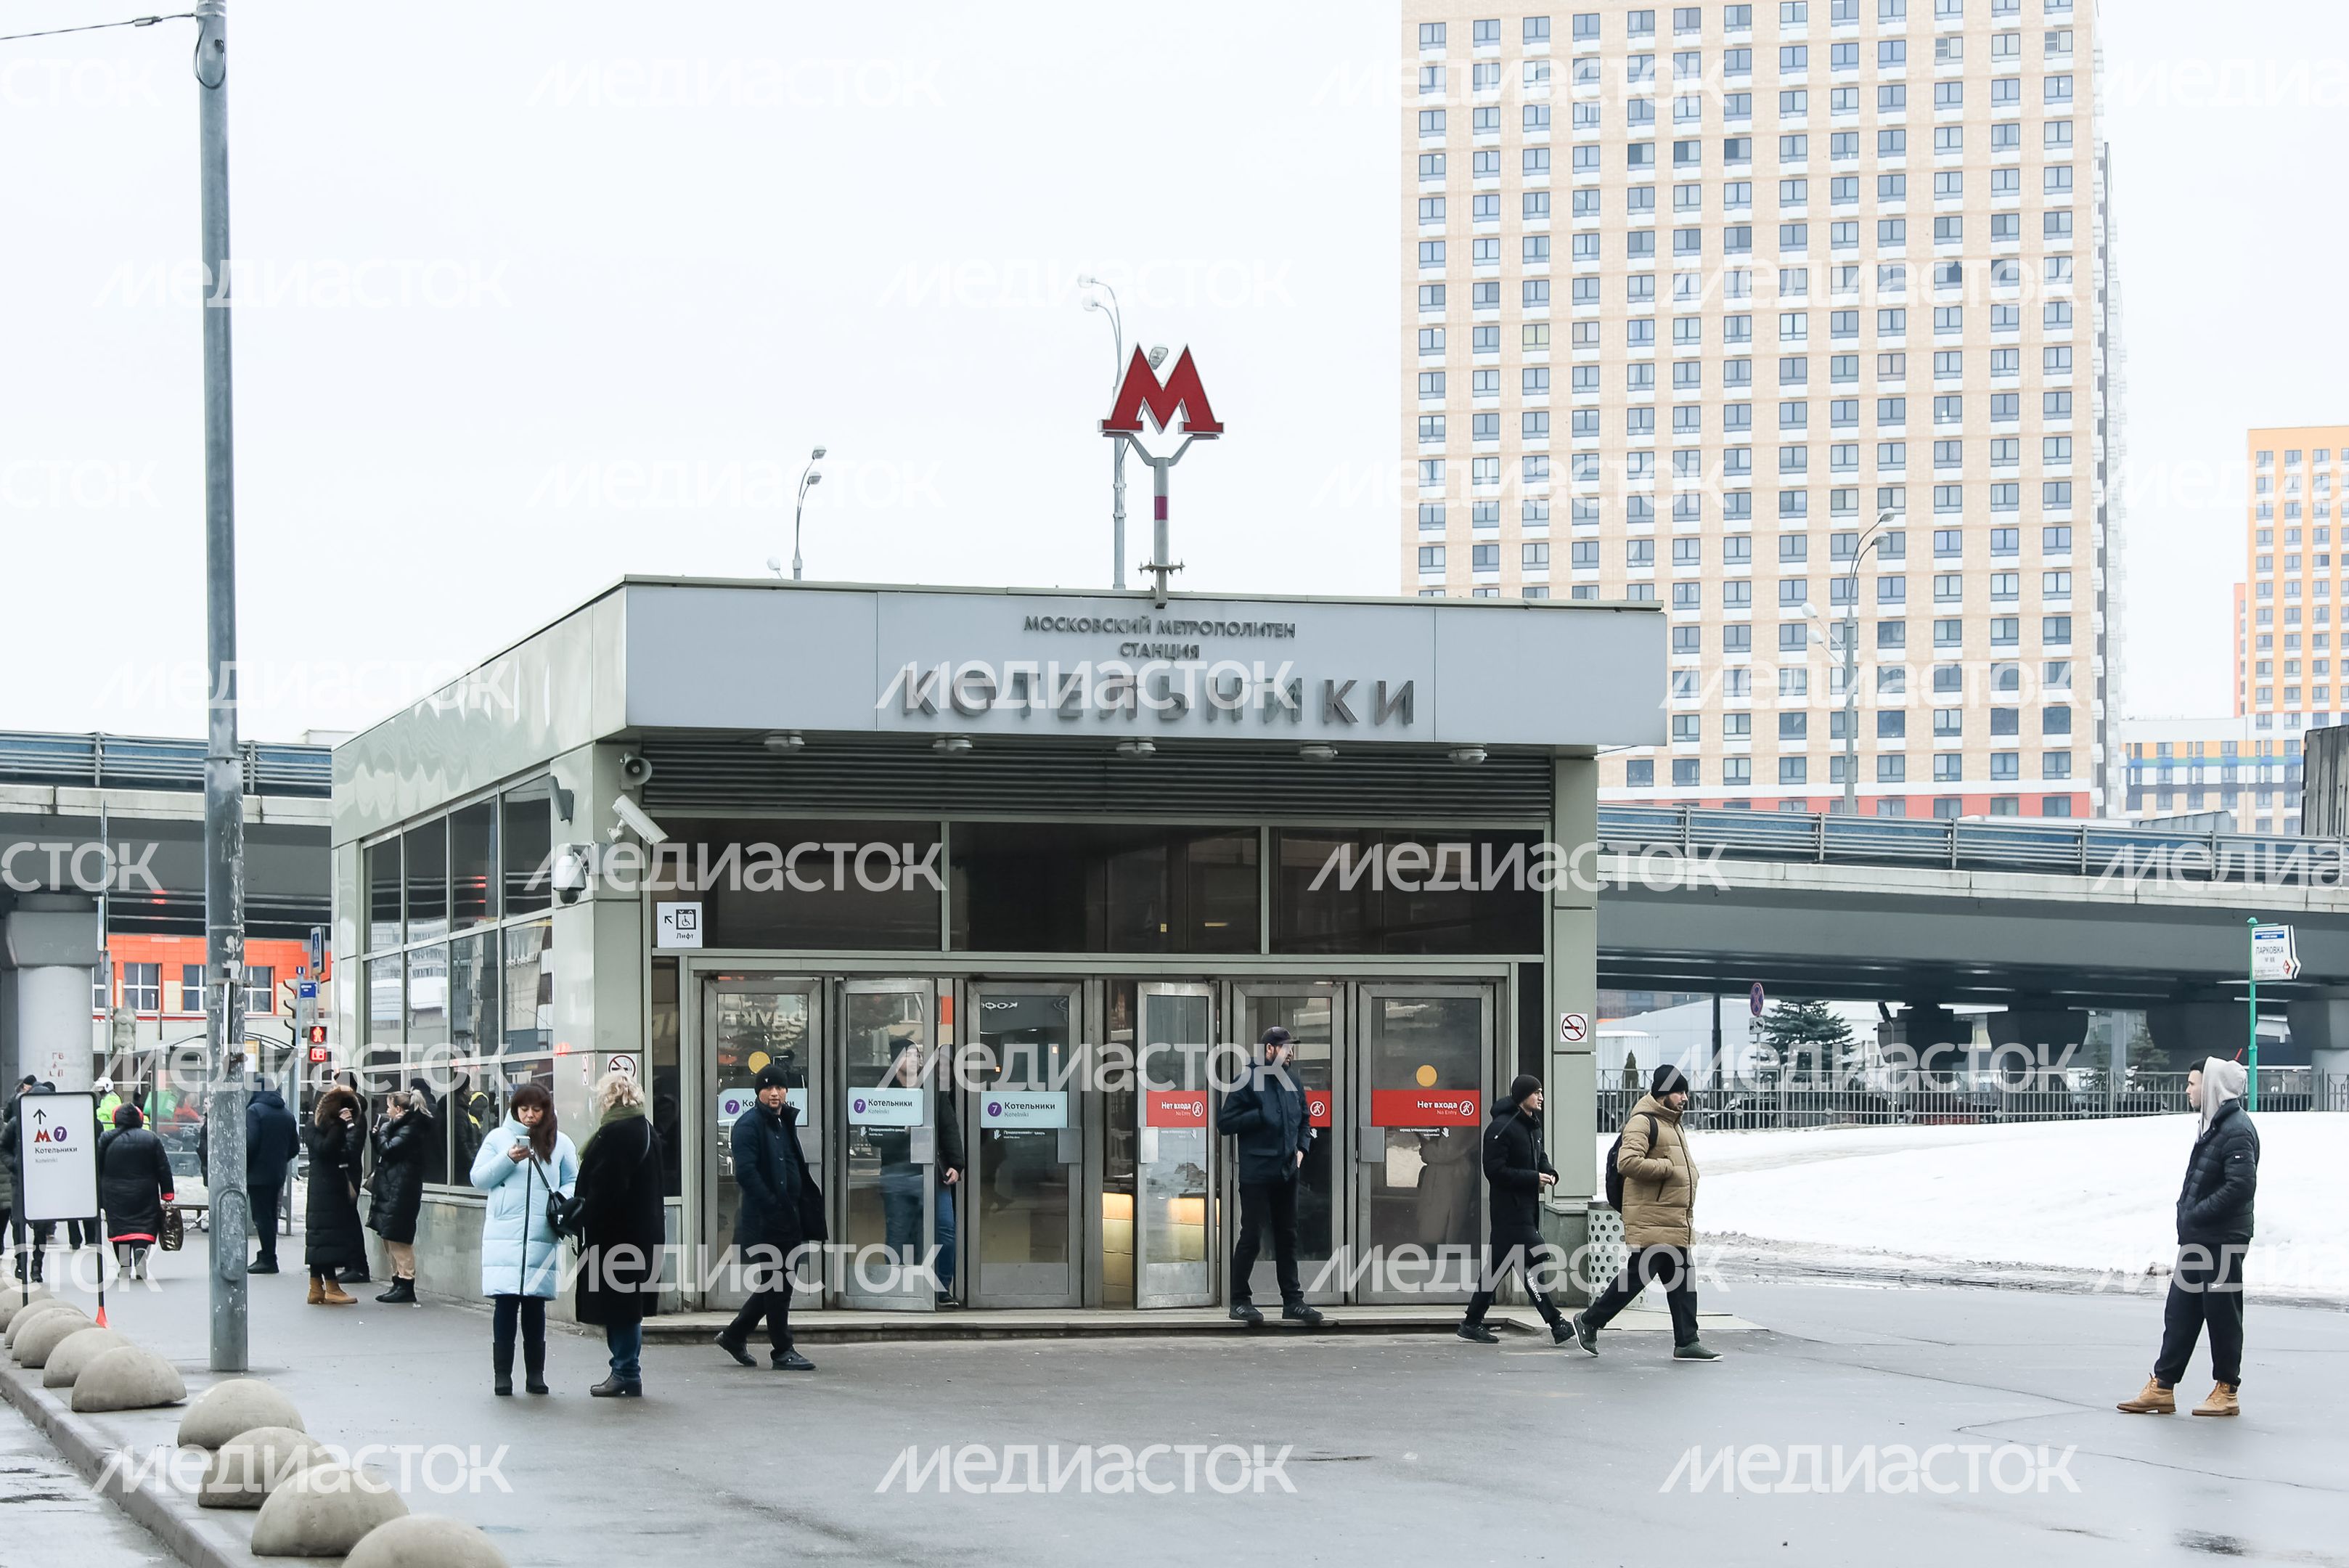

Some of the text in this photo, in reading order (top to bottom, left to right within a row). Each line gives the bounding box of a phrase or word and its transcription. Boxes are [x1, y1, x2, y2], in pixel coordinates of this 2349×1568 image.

[1024, 616, 1296, 639] МОСКОВСКИЙ МЕТРОПОЛИТЕН
[1119, 642, 1201, 660] СТАНЦИЯ
[902, 669, 1414, 724] КОТЕЛЬНИКИ
[2255, 946, 2284, 955] ПАРКОВКА
[868, 1098, 912, 1107] Котельники
